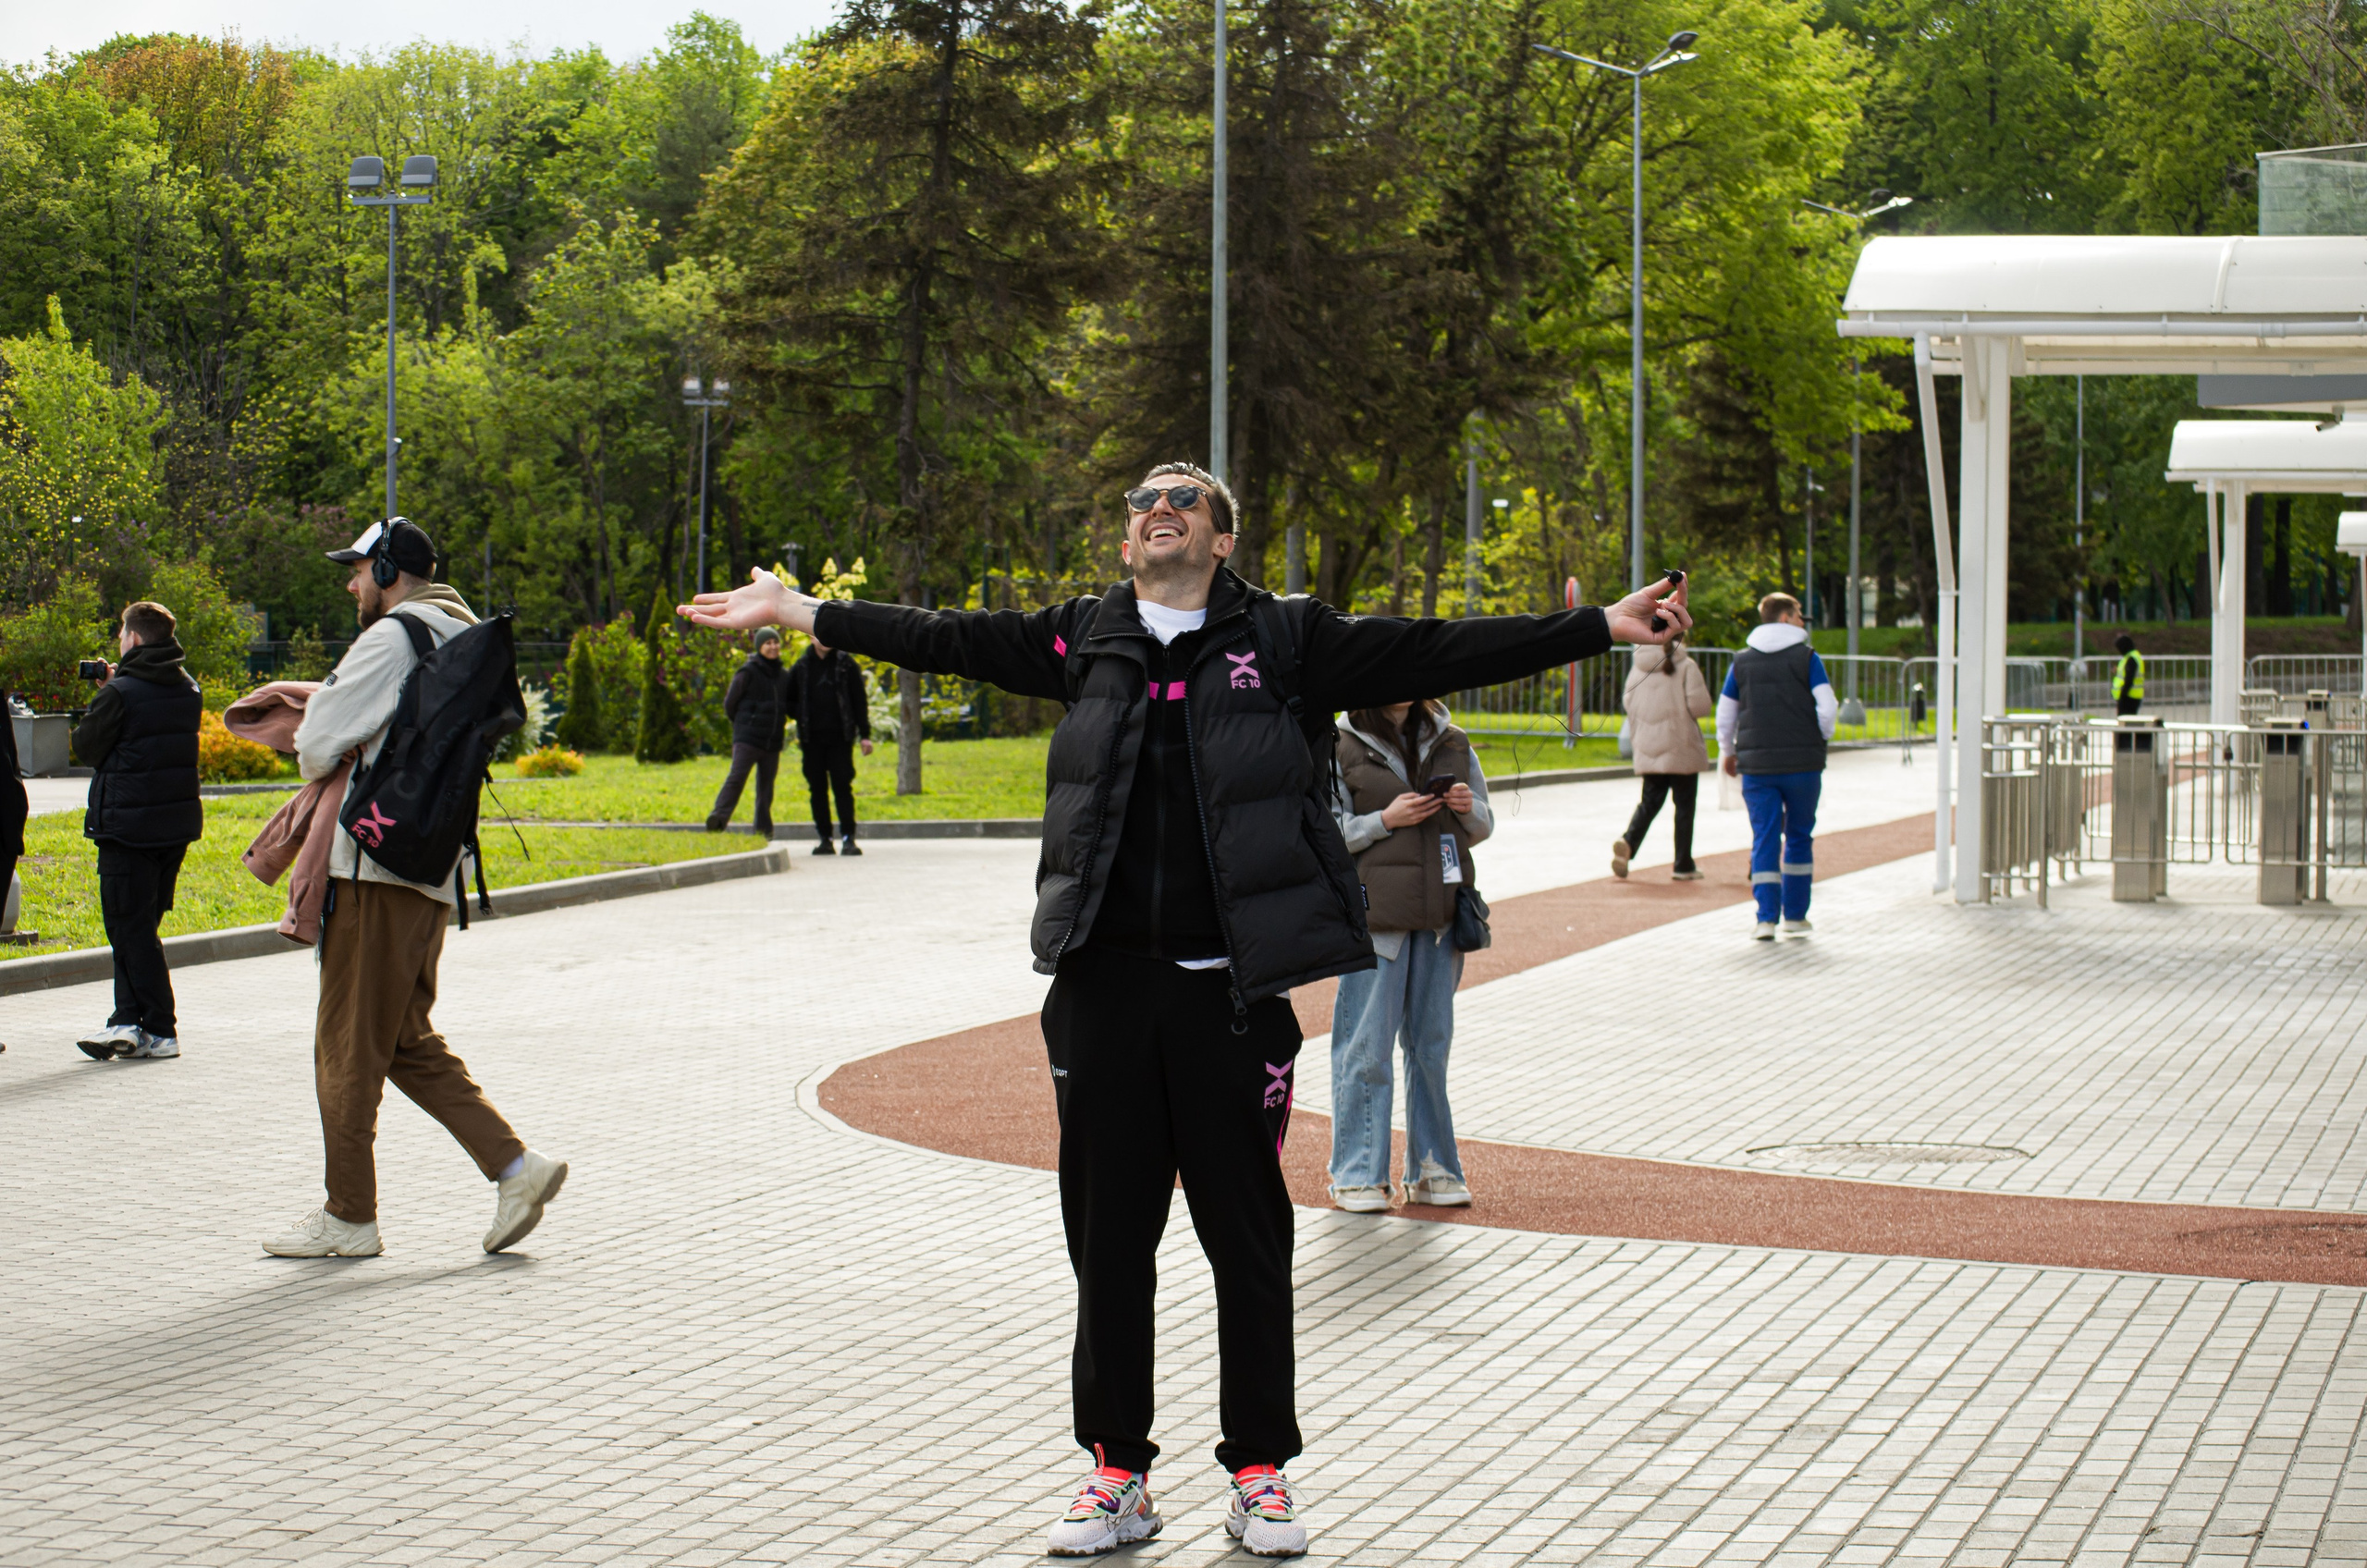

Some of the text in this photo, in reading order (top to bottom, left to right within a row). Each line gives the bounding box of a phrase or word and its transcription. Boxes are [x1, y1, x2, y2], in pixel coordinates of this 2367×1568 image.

[1232, 679, 1260, 689] FC 10
[351, 824, 379, 848] FC 10
[1264, 1093, 1284, 1109] FC 10
